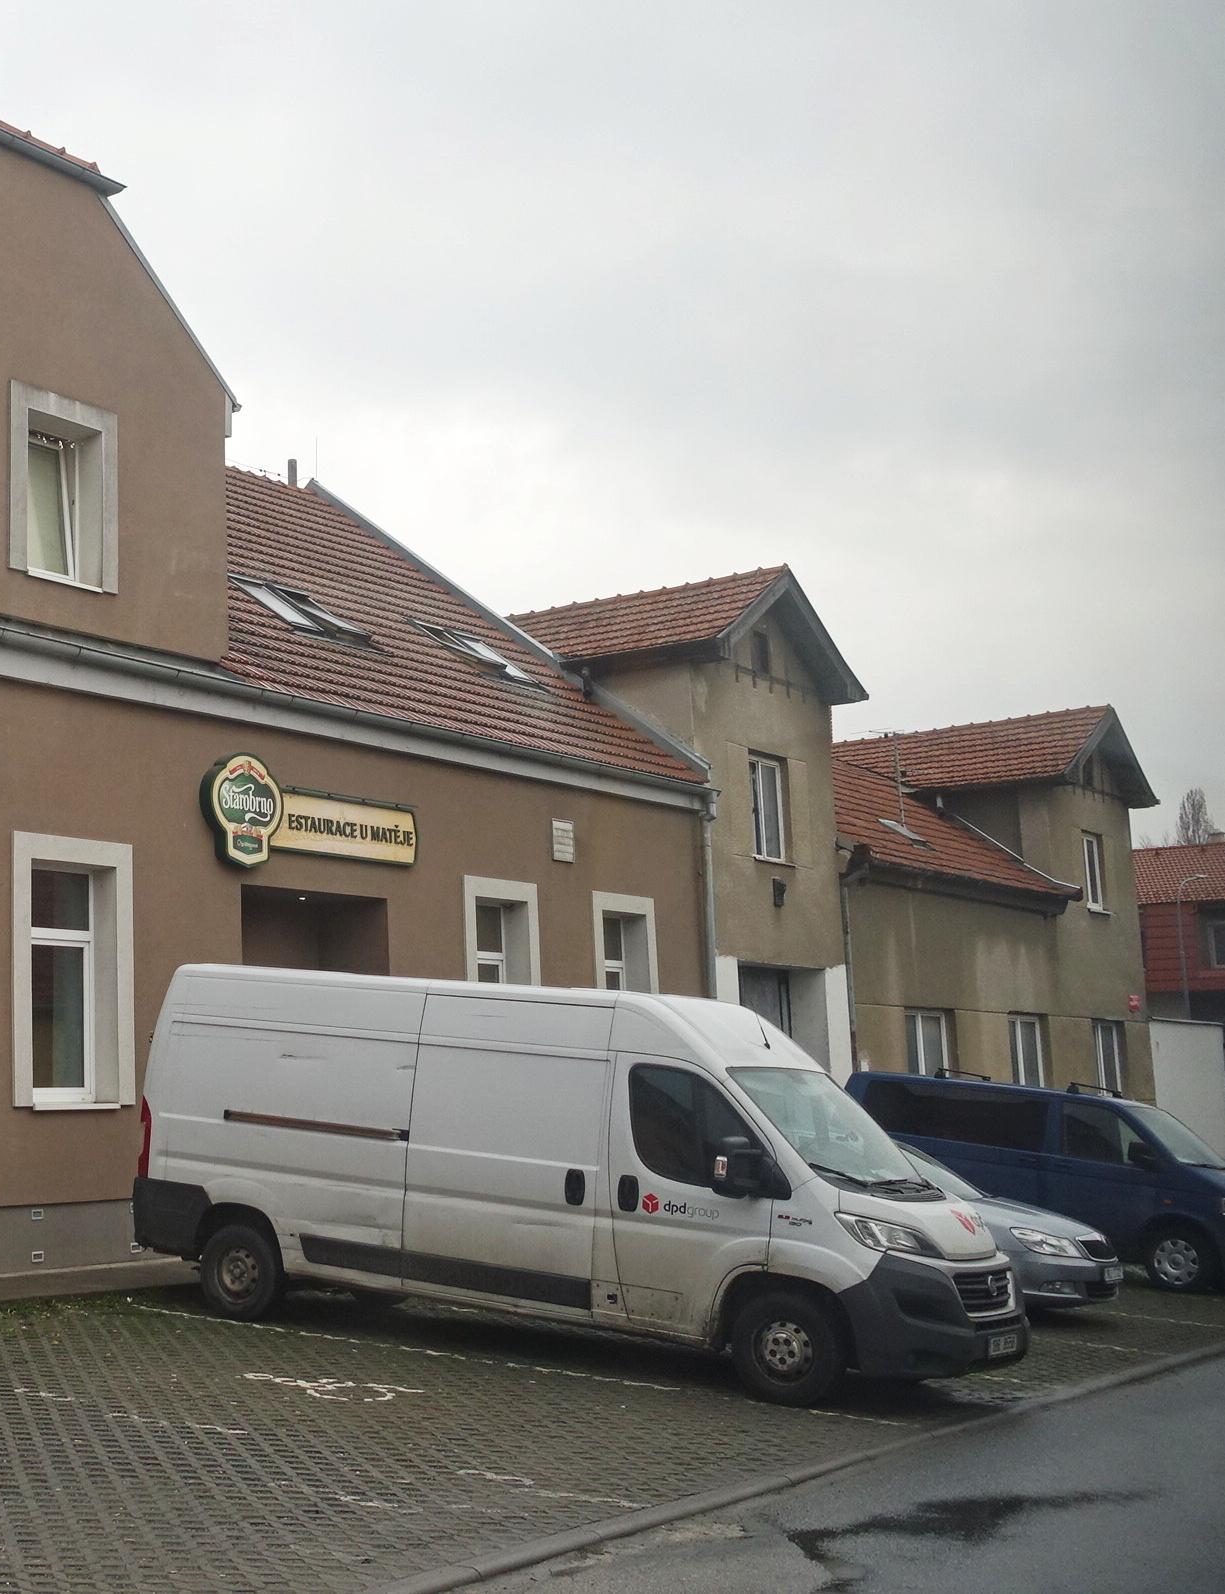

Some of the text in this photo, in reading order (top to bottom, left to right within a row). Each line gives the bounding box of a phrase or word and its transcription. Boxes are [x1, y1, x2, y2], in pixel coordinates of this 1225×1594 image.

[222, 780, 274, 822] Starobrno
[288, 813, 415, 847] ESTAURACE U MATĚJE
[663, 1200, 720, 1221] dpdgroup
